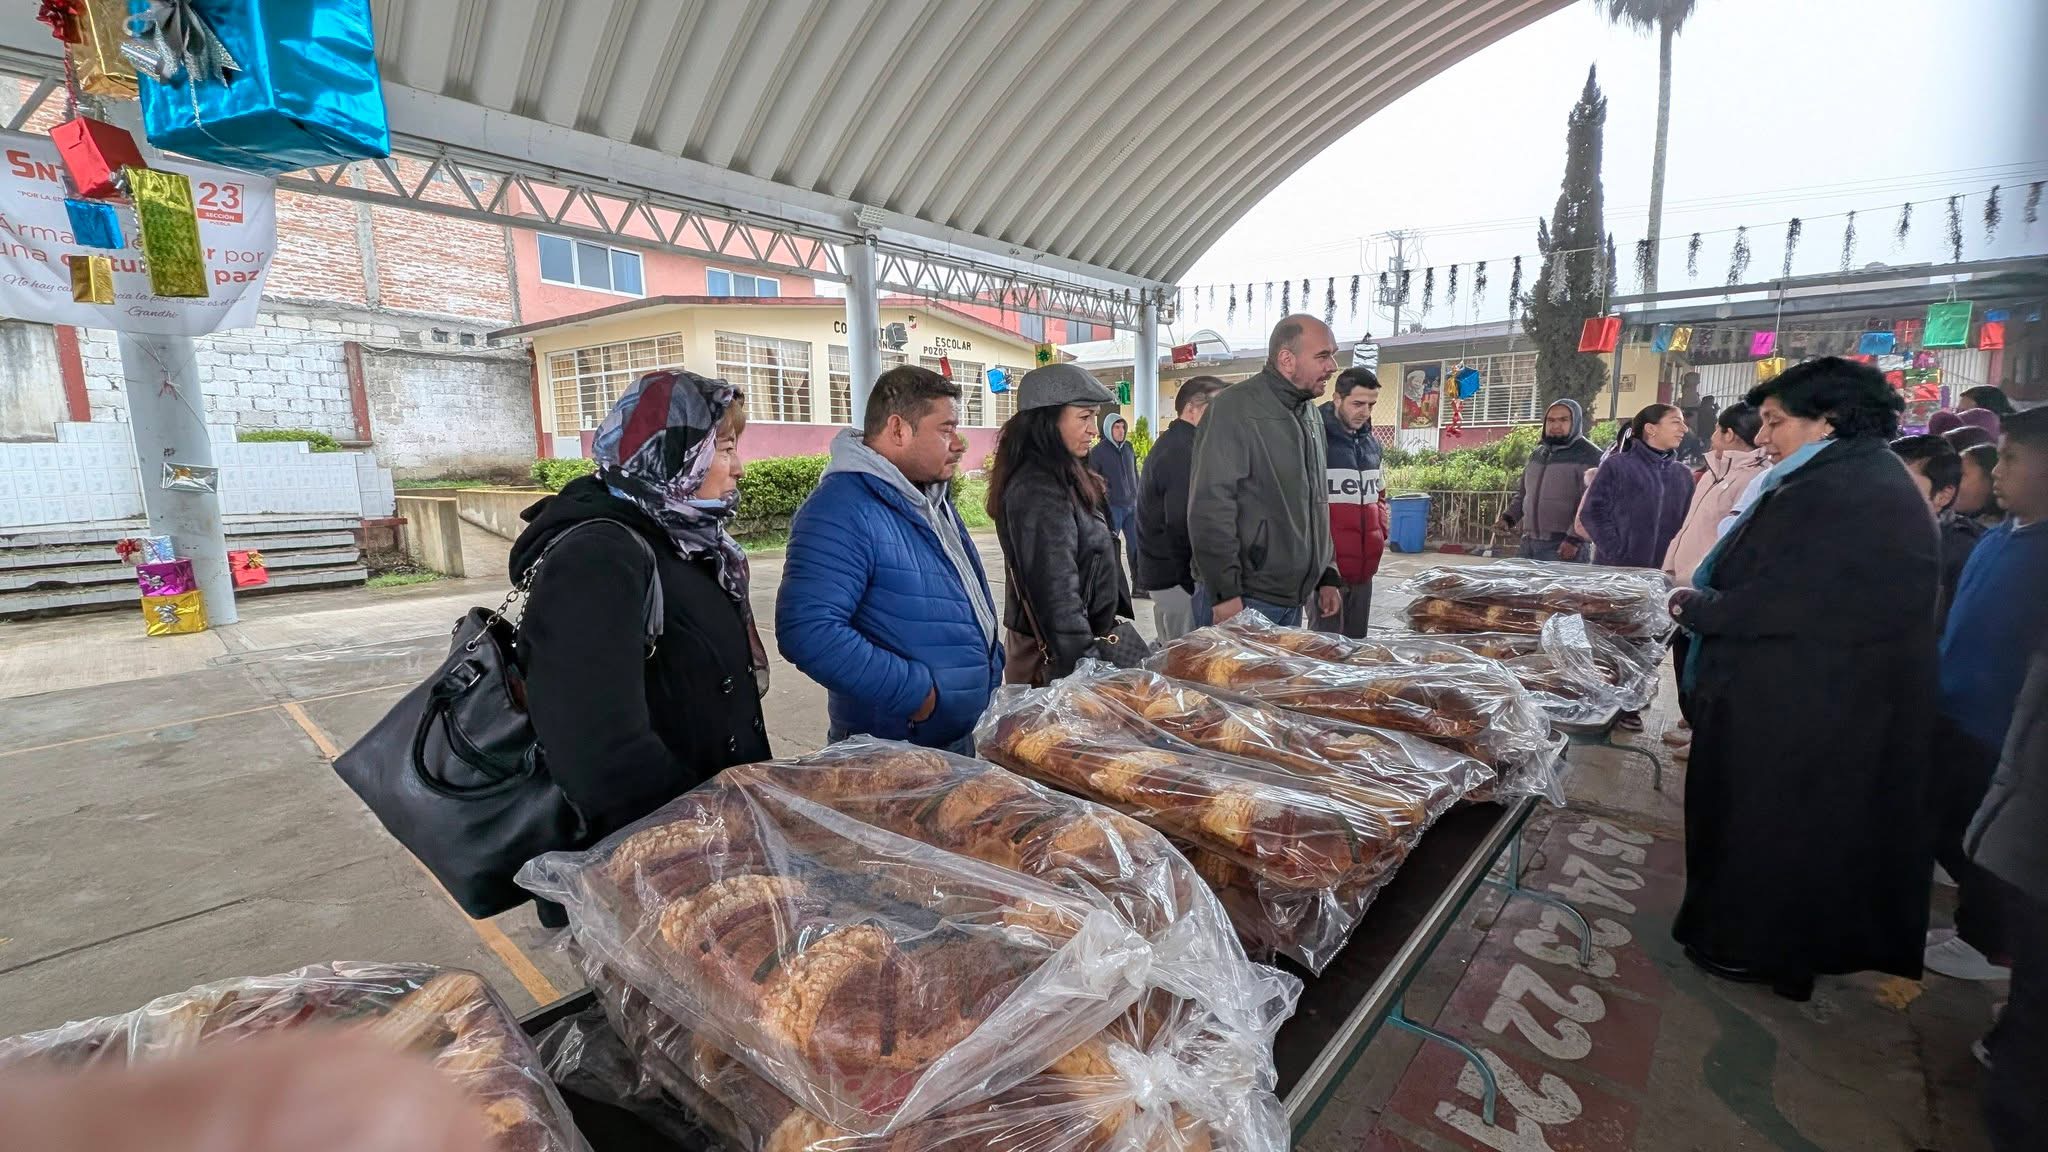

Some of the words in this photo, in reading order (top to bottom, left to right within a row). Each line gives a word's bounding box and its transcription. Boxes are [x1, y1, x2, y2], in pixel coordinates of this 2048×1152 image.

[199, 182, 240, 210] 23
[225, 249, 264, 265] por
[31, 280, 55, 293] hay
[923, 345, 948, 356] POZOS
[935, 336, 972, 351] ESCOLAR
[1567, 819, 1654, 865] 25
[1548, 854, 1646, 914] 24
[1513, 905, 1633, 979] 23
[1482, 963, 1606, 1060] 22
